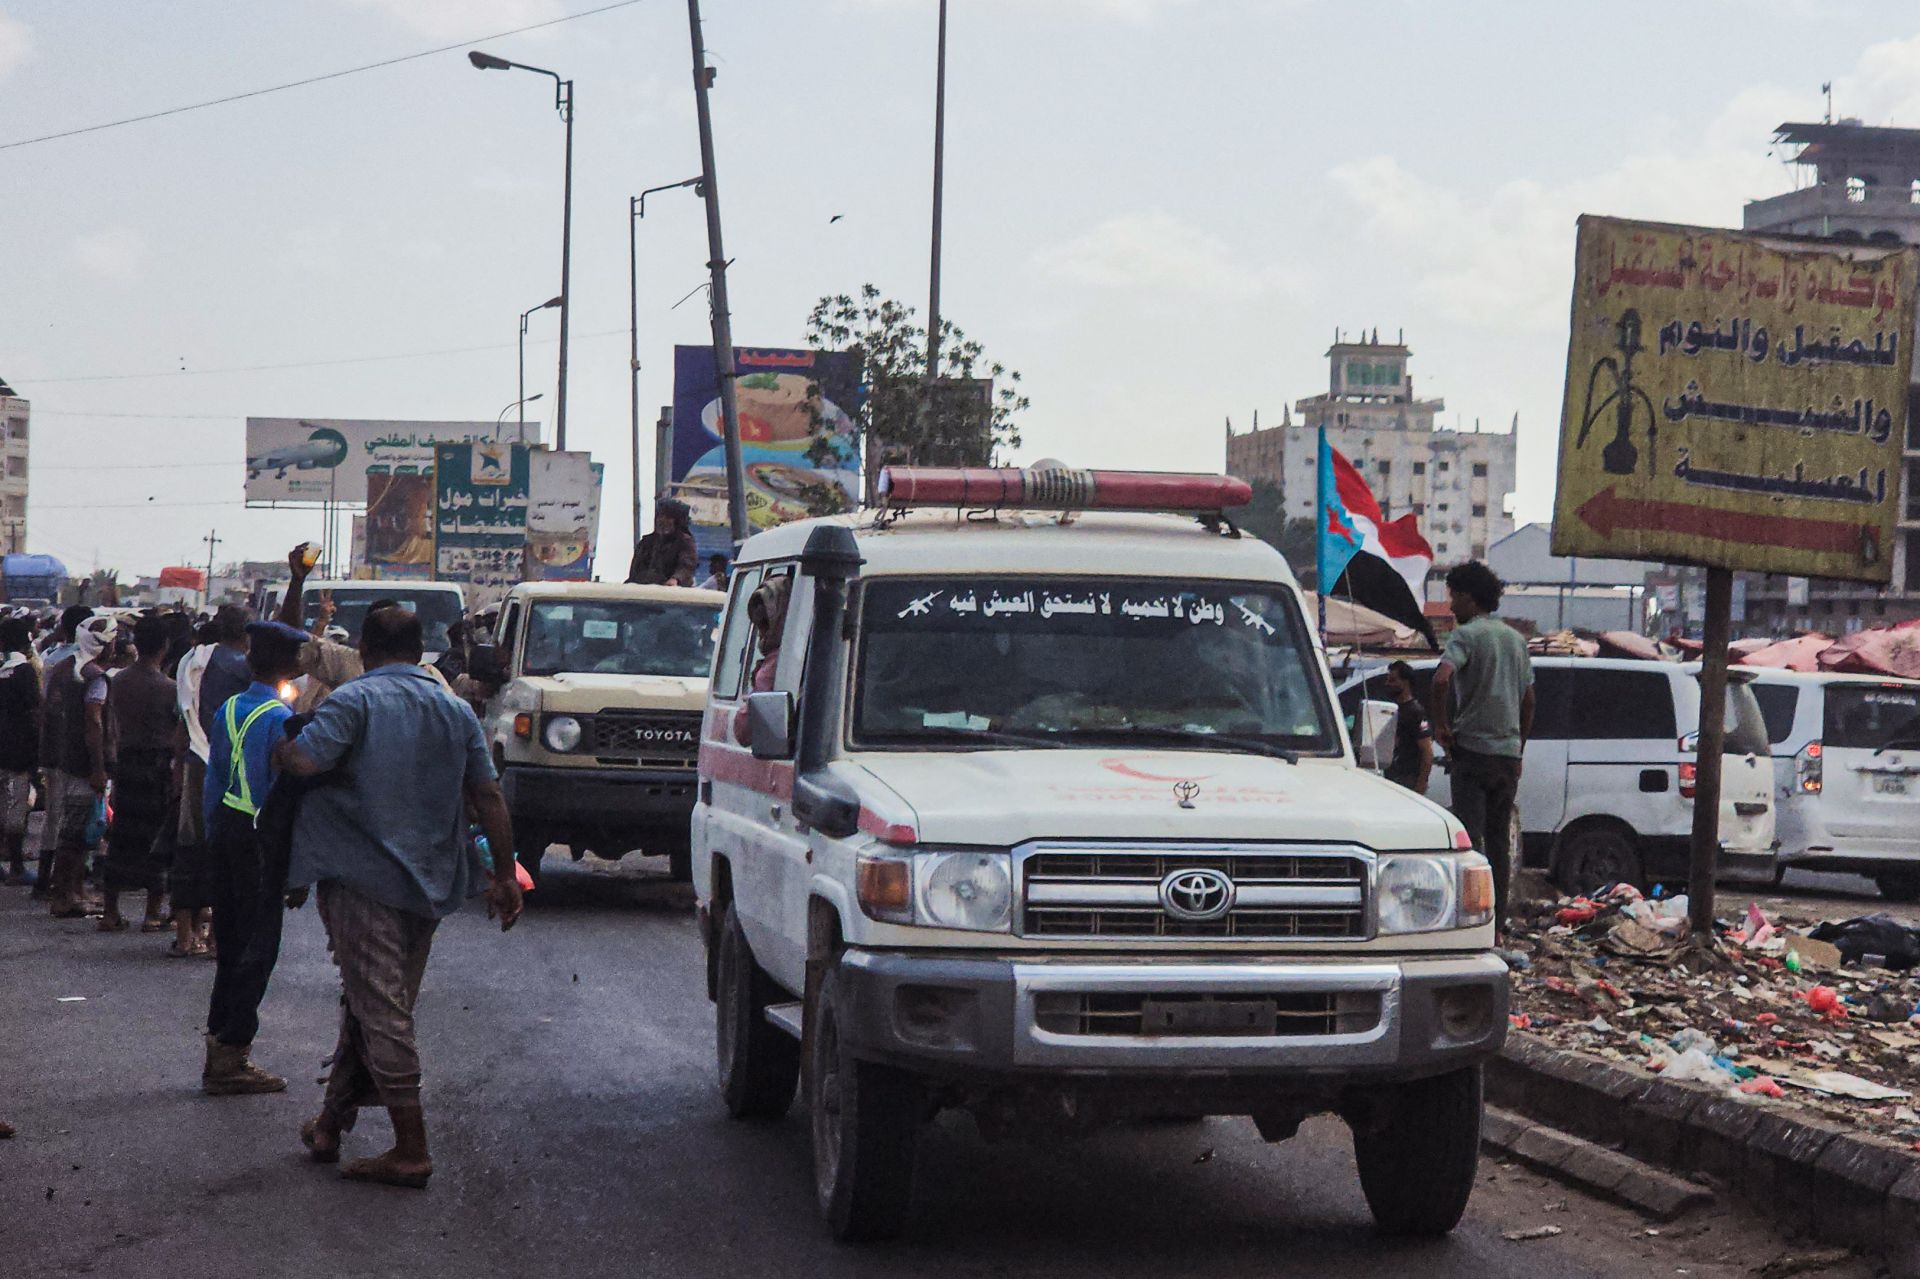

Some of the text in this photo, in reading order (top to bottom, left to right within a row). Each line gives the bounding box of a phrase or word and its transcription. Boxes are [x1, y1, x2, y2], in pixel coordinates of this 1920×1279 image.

[1659, 316, 1899, 367] للمقيل والنوم
[1663, 379, 1892, 444] والشيش
[364, 431, 415, 455] المفلحي
[439, 487, 473, 512] مول
[949, 589, 1224, 626] وطن لا نحميه لا نستحق العيش فيه
[635, 729, 693, 741] TOYOTA
